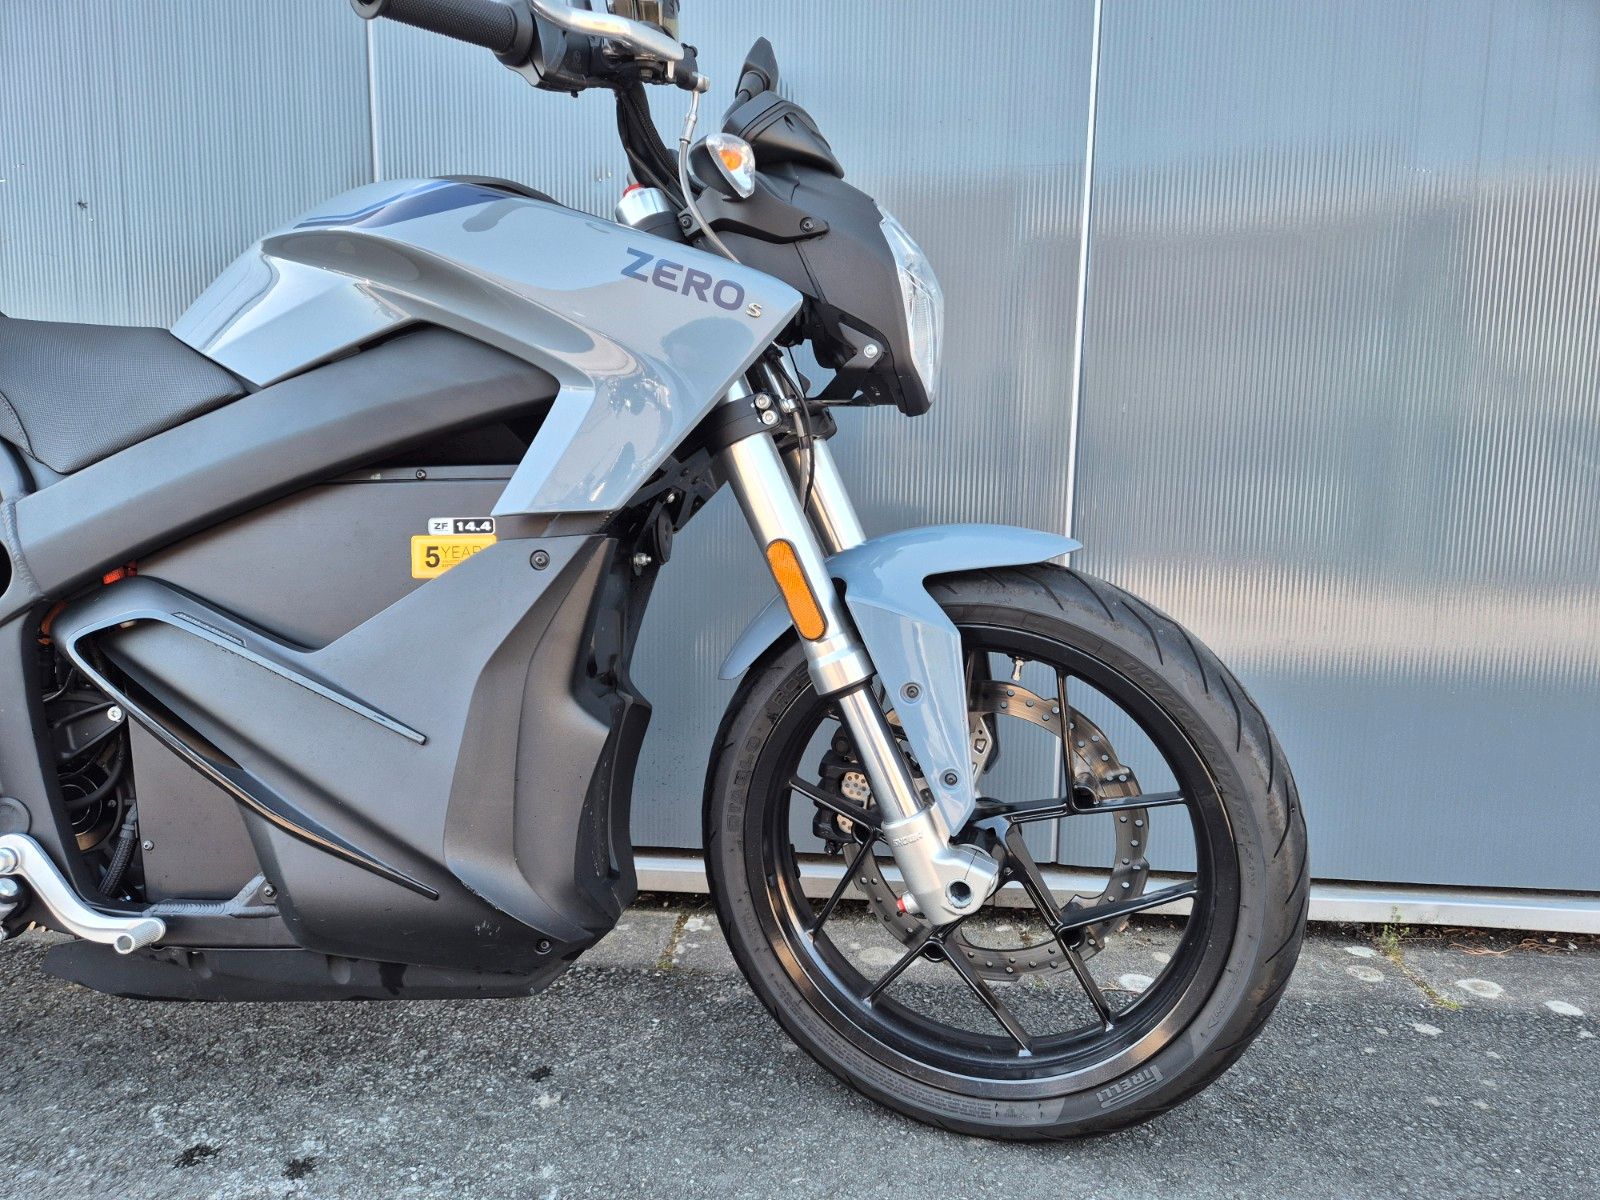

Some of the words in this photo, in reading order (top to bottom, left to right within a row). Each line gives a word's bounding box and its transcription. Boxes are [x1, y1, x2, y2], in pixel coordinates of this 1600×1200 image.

[620, 246, 745, 311] ZERO
[746, 302, 763, 318] S
[433, 522, 449, 530] ZF
[456, 520, 492, 532] 14.4
[425, 546, 440, 568] 5
[1096, 1065, 1164, 1109] PIRELLI
